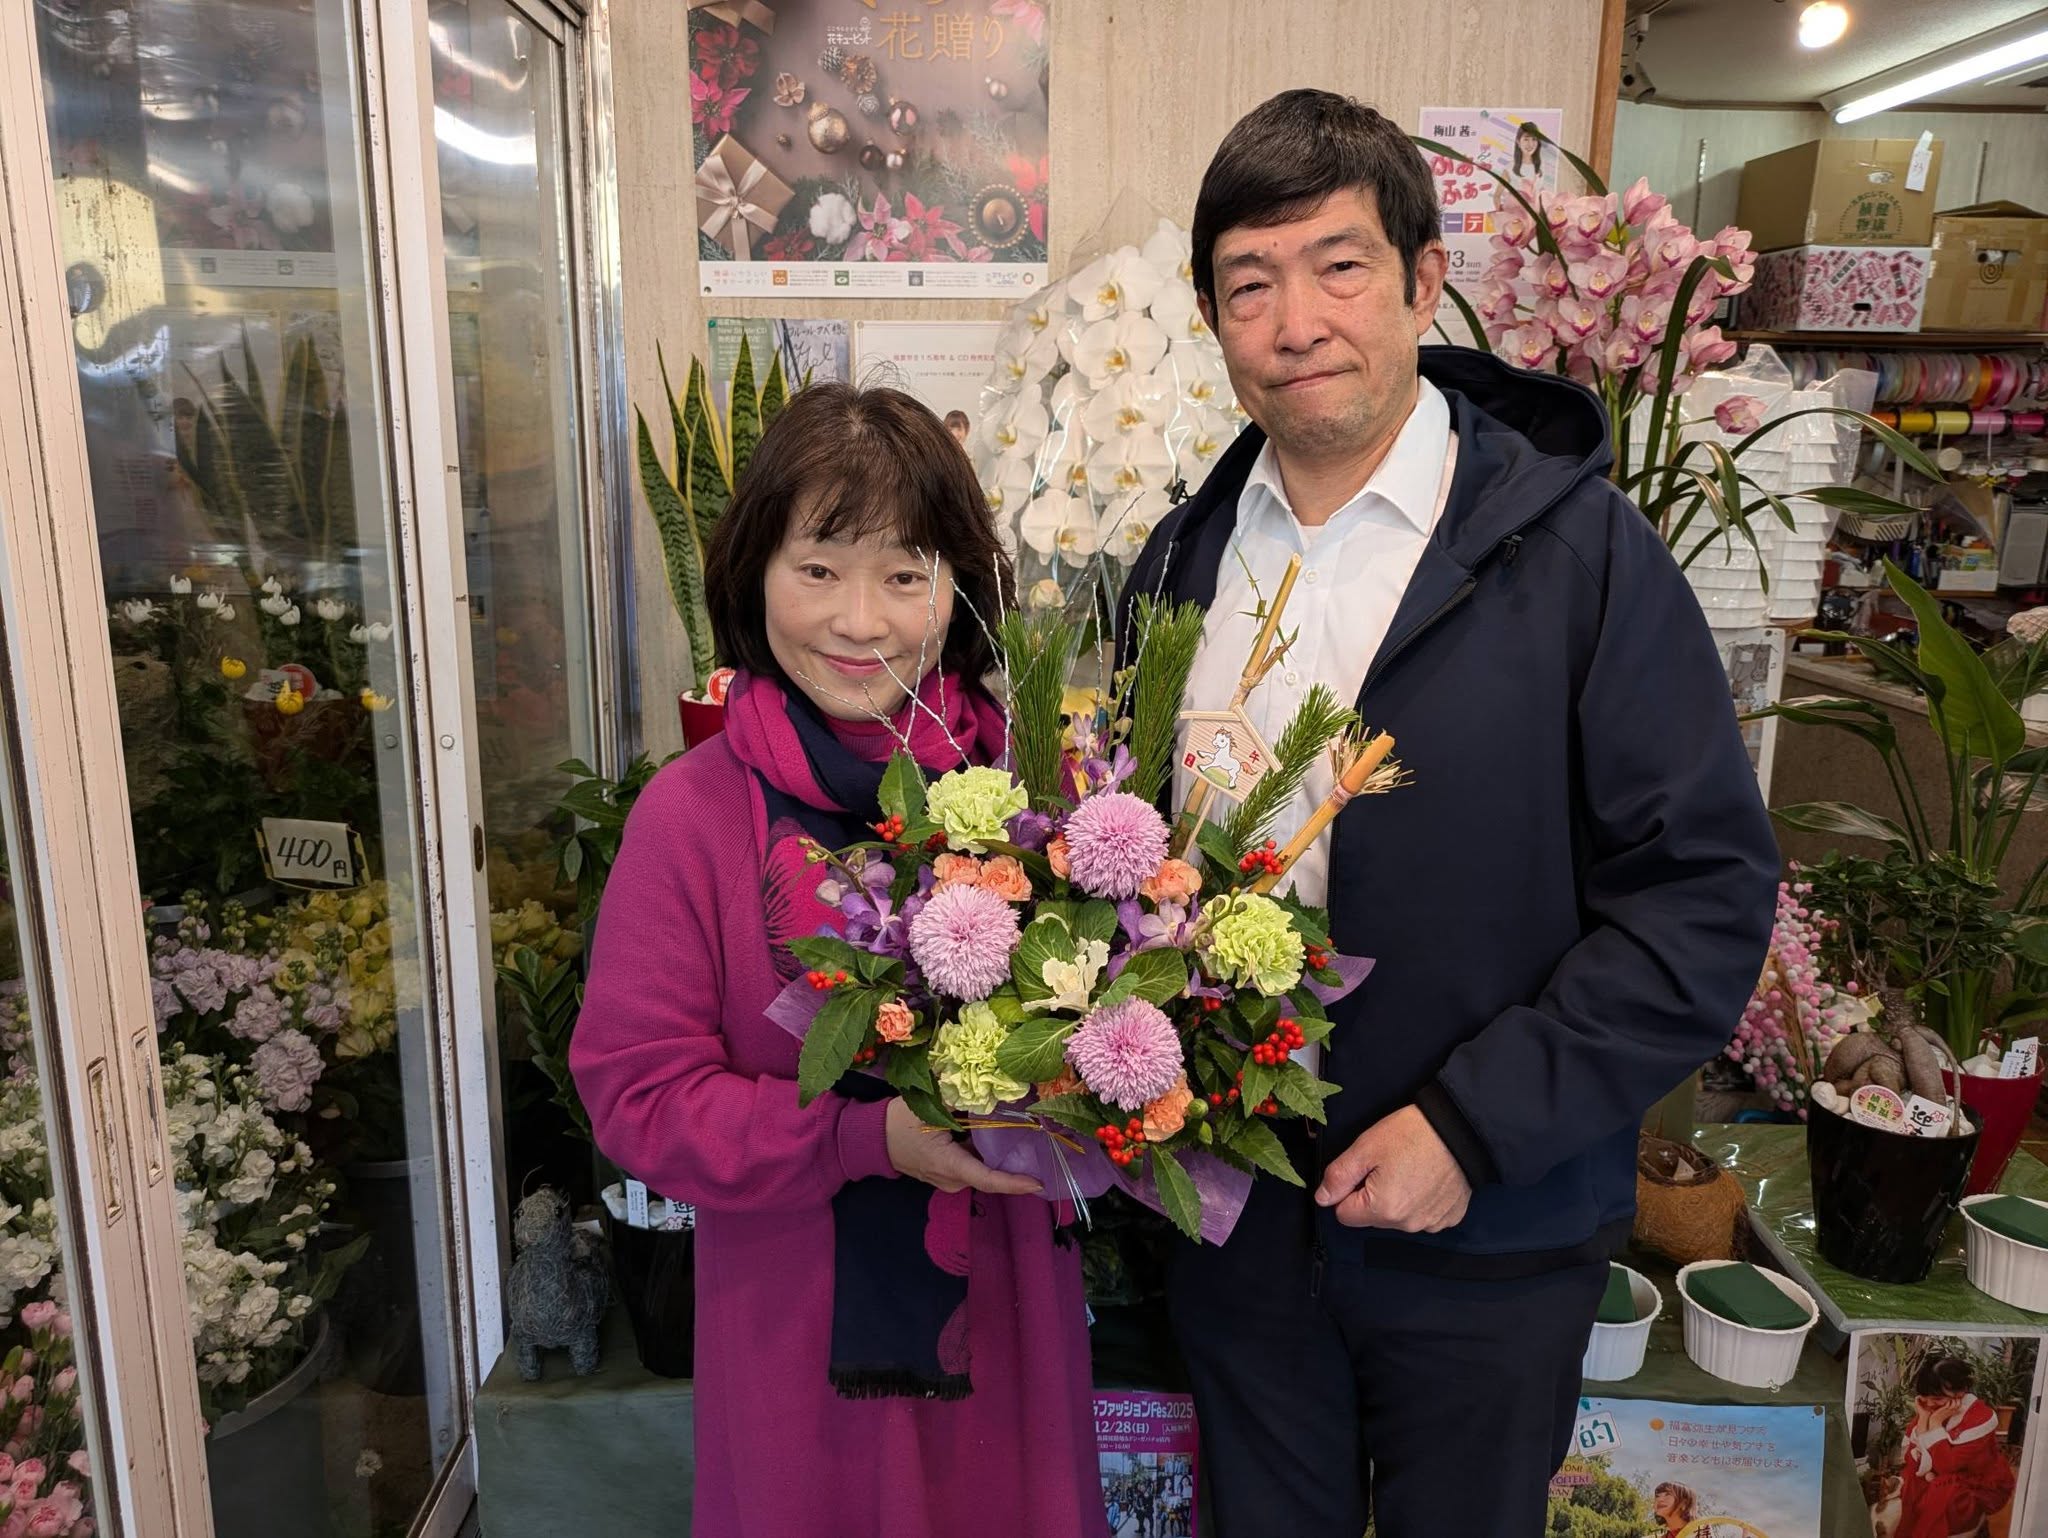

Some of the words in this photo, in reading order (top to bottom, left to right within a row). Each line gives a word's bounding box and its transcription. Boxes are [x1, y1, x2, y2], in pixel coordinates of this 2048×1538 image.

[875, 11, 1004, 63] 花贈り
[1434, 125, 1456, 137] 梅山
[1093, 1400, 1194, 1419] ファッションFes2025
[1668, 1436, 1777, 1452] 日々の幸せや気づきを
